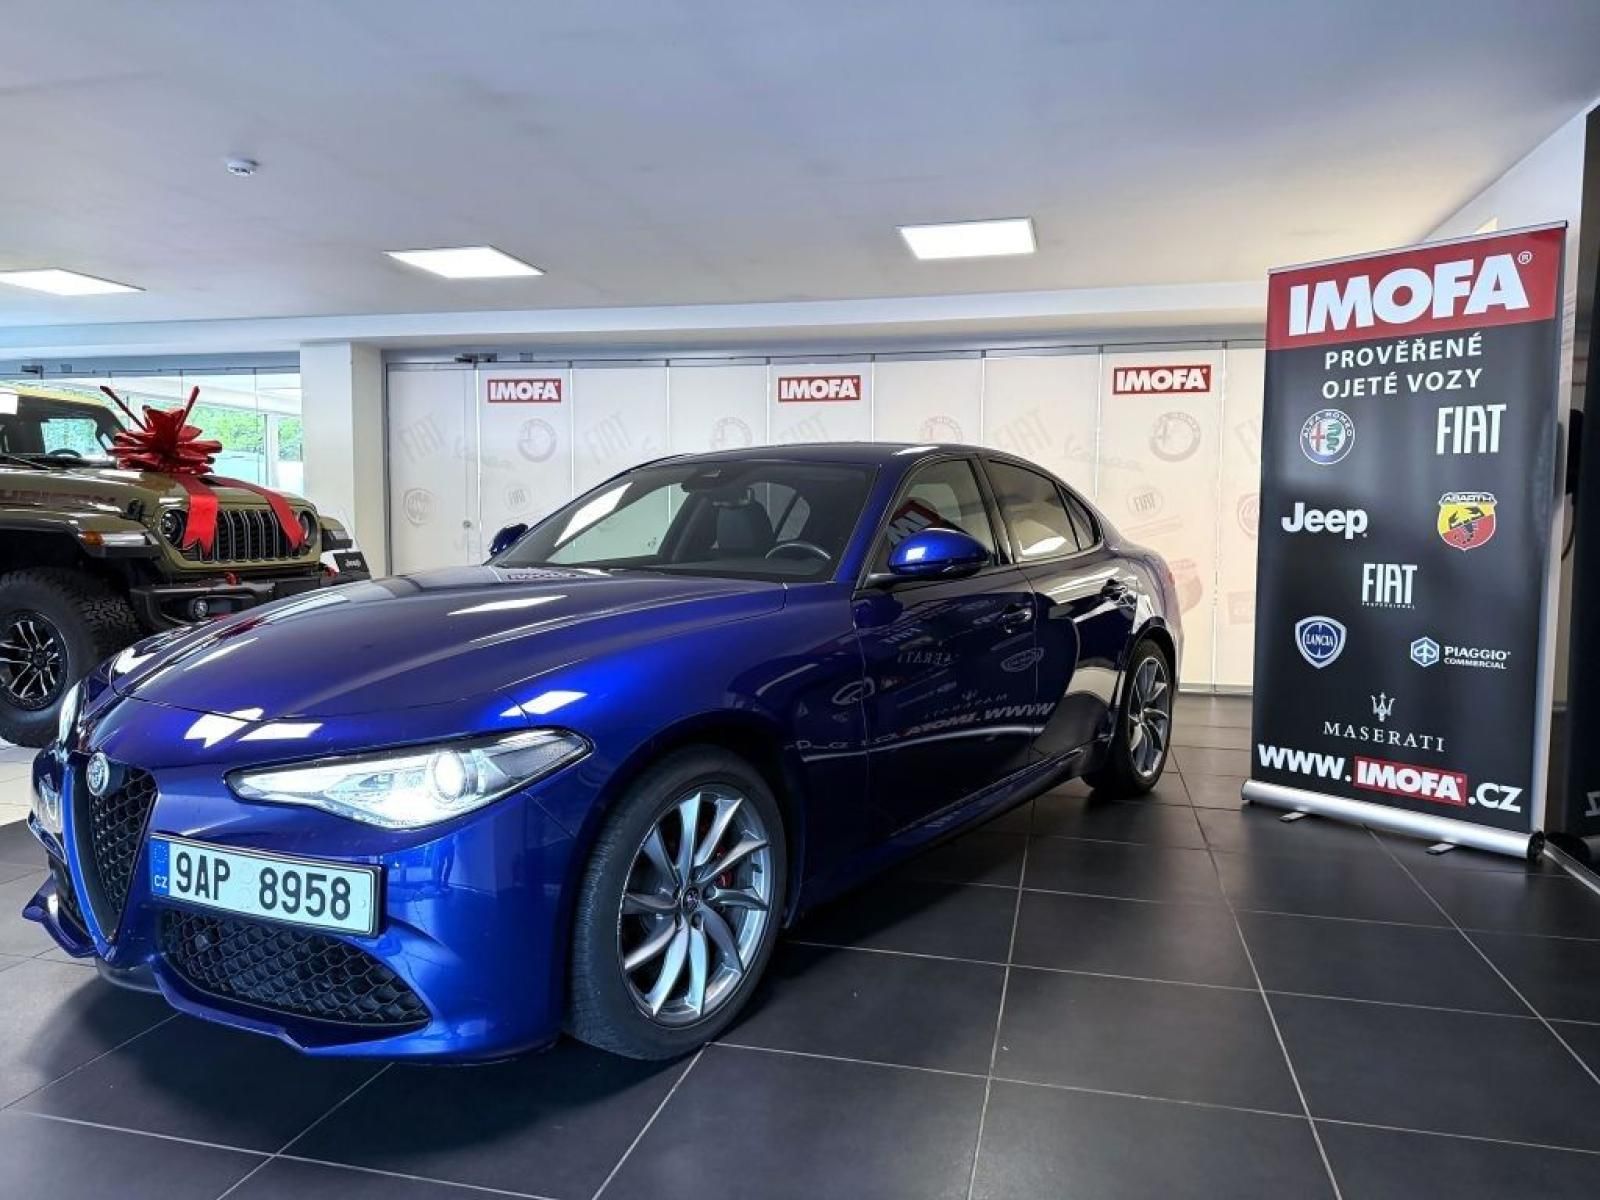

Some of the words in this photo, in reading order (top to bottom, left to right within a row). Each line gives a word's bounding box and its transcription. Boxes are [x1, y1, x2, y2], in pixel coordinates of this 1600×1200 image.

[1325, 332, 1483, 370] PROVĚŘENÉ
[490, 381, 560, 400] IMOFA
[780, 377, 857, 399] IMOFA
[1116, 367, 1207, 393] IMOFA
[1322, 371, 1398, 399] OJETÉ
[1407, 368, 1483, 393] VOZY
[1436, 404, 1507, 455] FIAT
[1281, 502, 1368, 540] Jeep
[1362, 563, 1418, 604] FIAT
[1444, 657, 1507, 670] COMMERCIAL
[1323, 721, 1445, 752] MASERATI
[154, 874, 168, 889] CZ
[175, 851, 231, 901] 9AP
[258, 866, 351, 921] 8958
